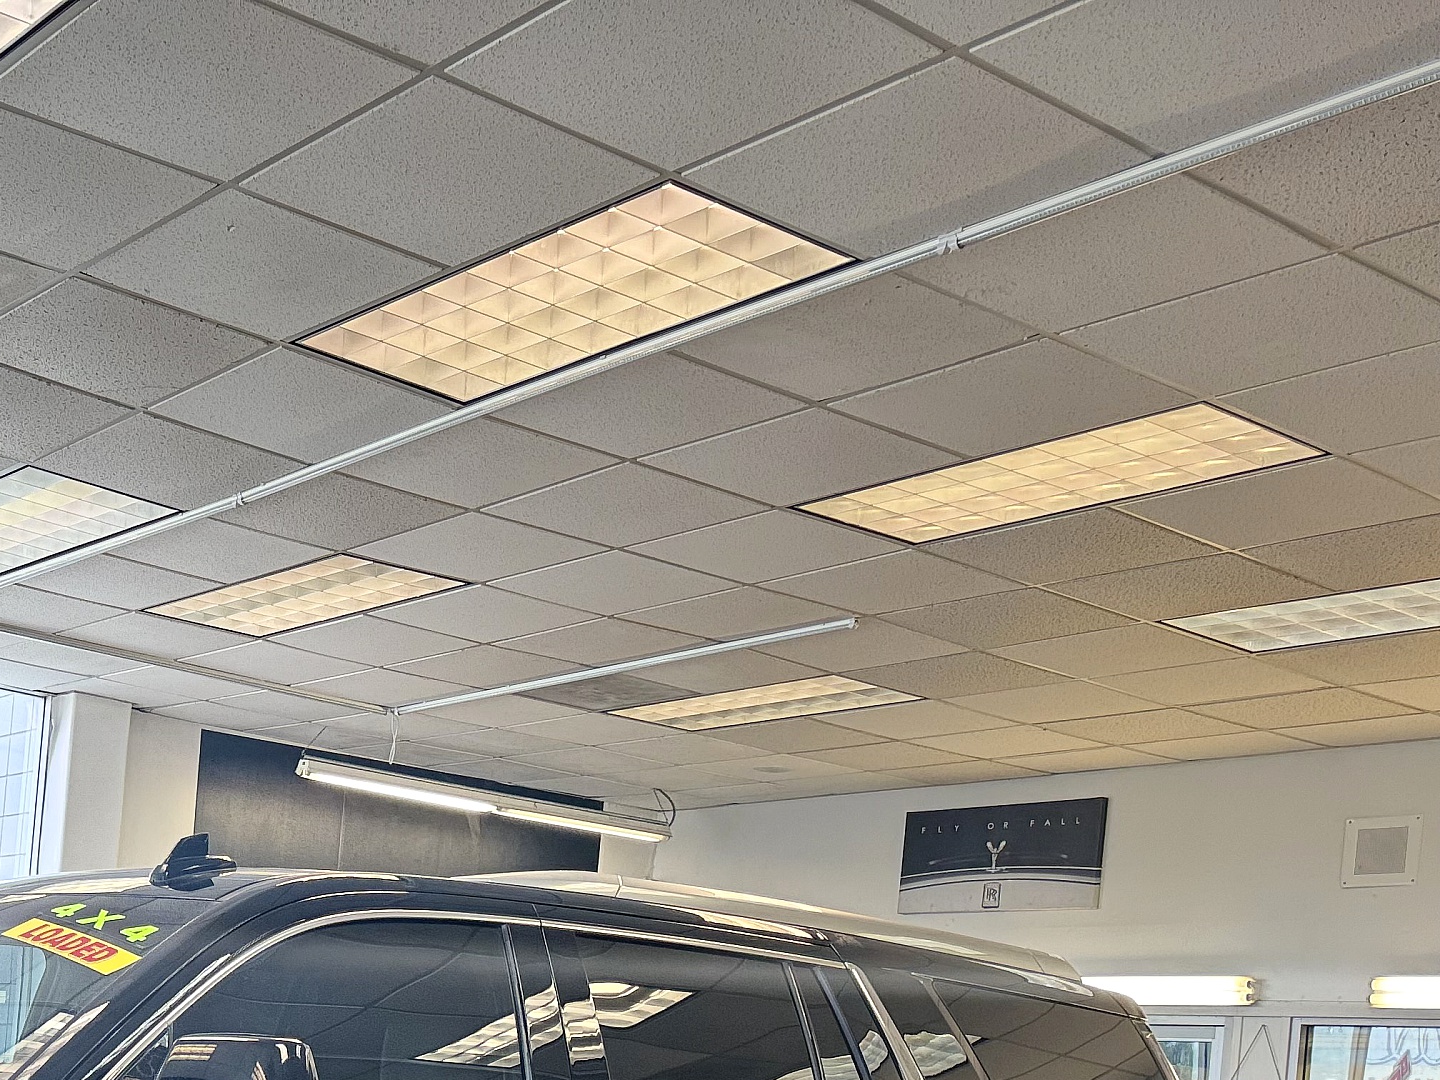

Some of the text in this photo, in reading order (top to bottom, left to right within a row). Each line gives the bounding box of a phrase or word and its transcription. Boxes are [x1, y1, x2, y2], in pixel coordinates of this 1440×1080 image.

[921, 816, 1080, 834] FLY OR FALL
[20, 923, 119, 963] LOADED
